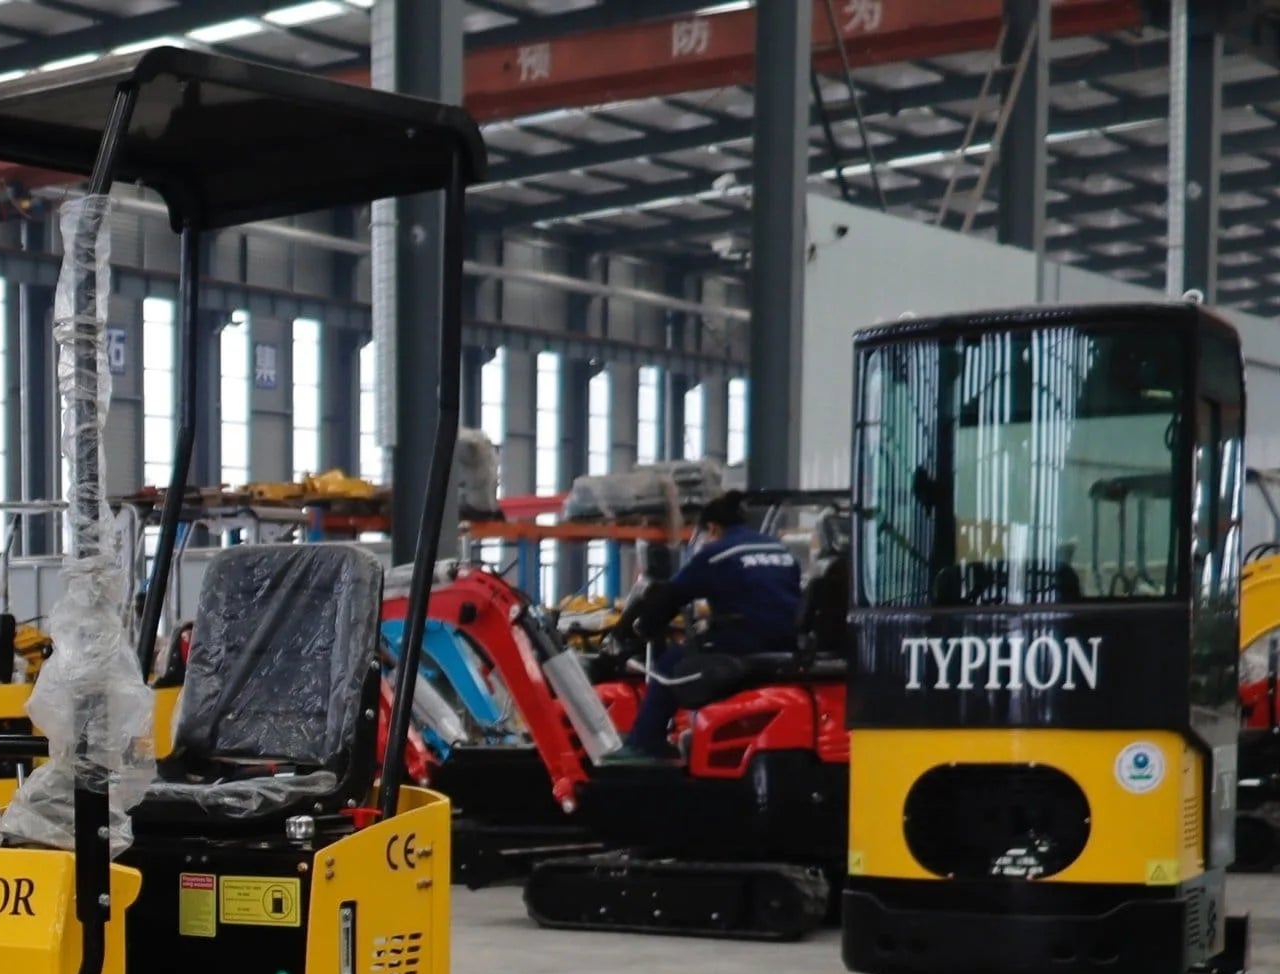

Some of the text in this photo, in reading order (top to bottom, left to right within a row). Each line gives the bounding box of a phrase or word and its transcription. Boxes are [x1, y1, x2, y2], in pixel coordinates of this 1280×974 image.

[517, 43, 551, 80] 预
[671, 21, 709, 57] 防
[900, 636, 1102, 690] TYPHON
[386, 833, 416, 871] CE
